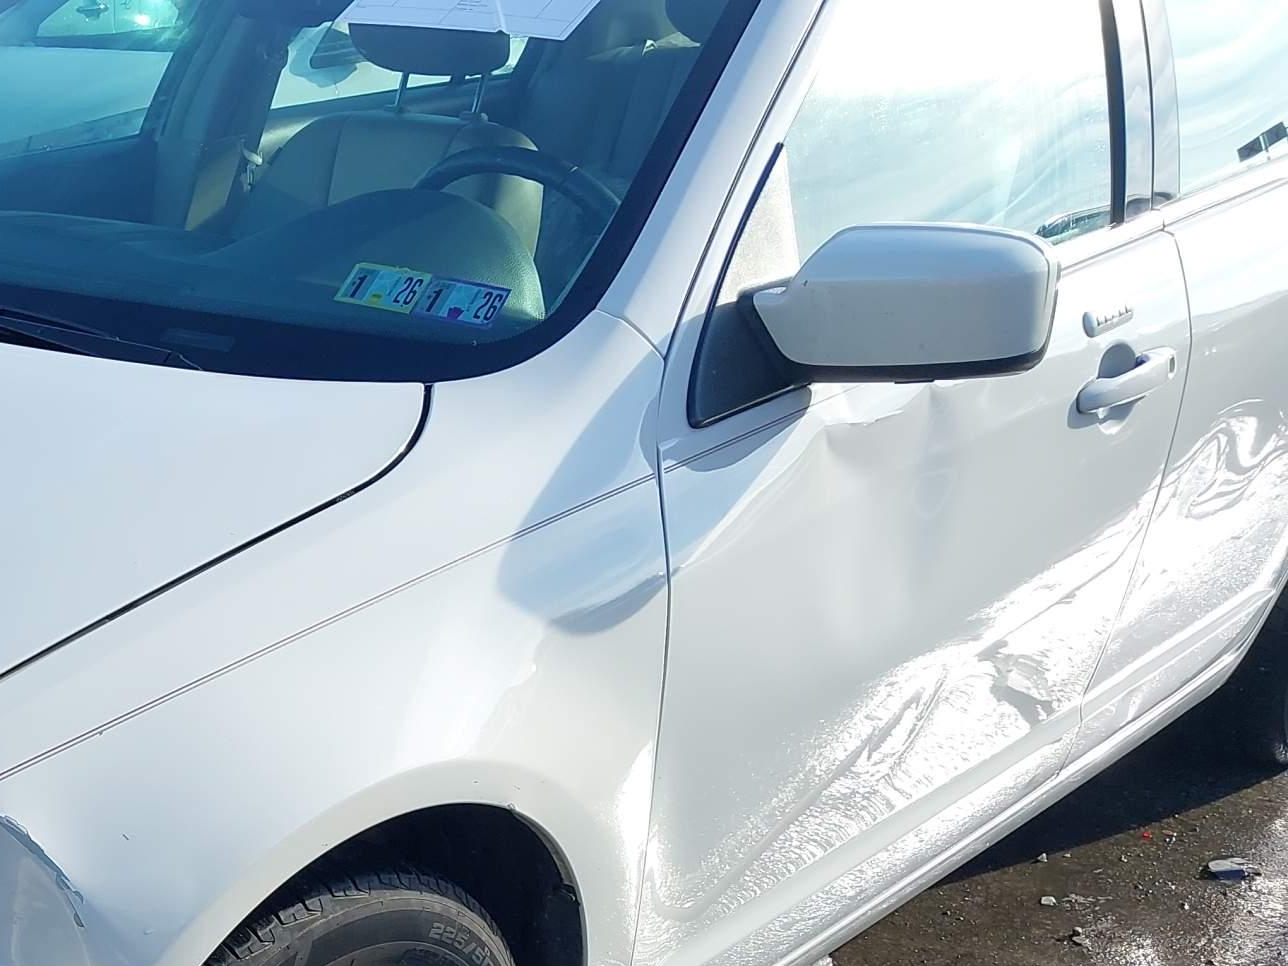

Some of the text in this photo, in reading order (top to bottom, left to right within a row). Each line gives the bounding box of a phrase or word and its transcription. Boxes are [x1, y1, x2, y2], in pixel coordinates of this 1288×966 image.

[350, 274, 424, 306] 1 26
[425, 288, 504, 321] 1 26
